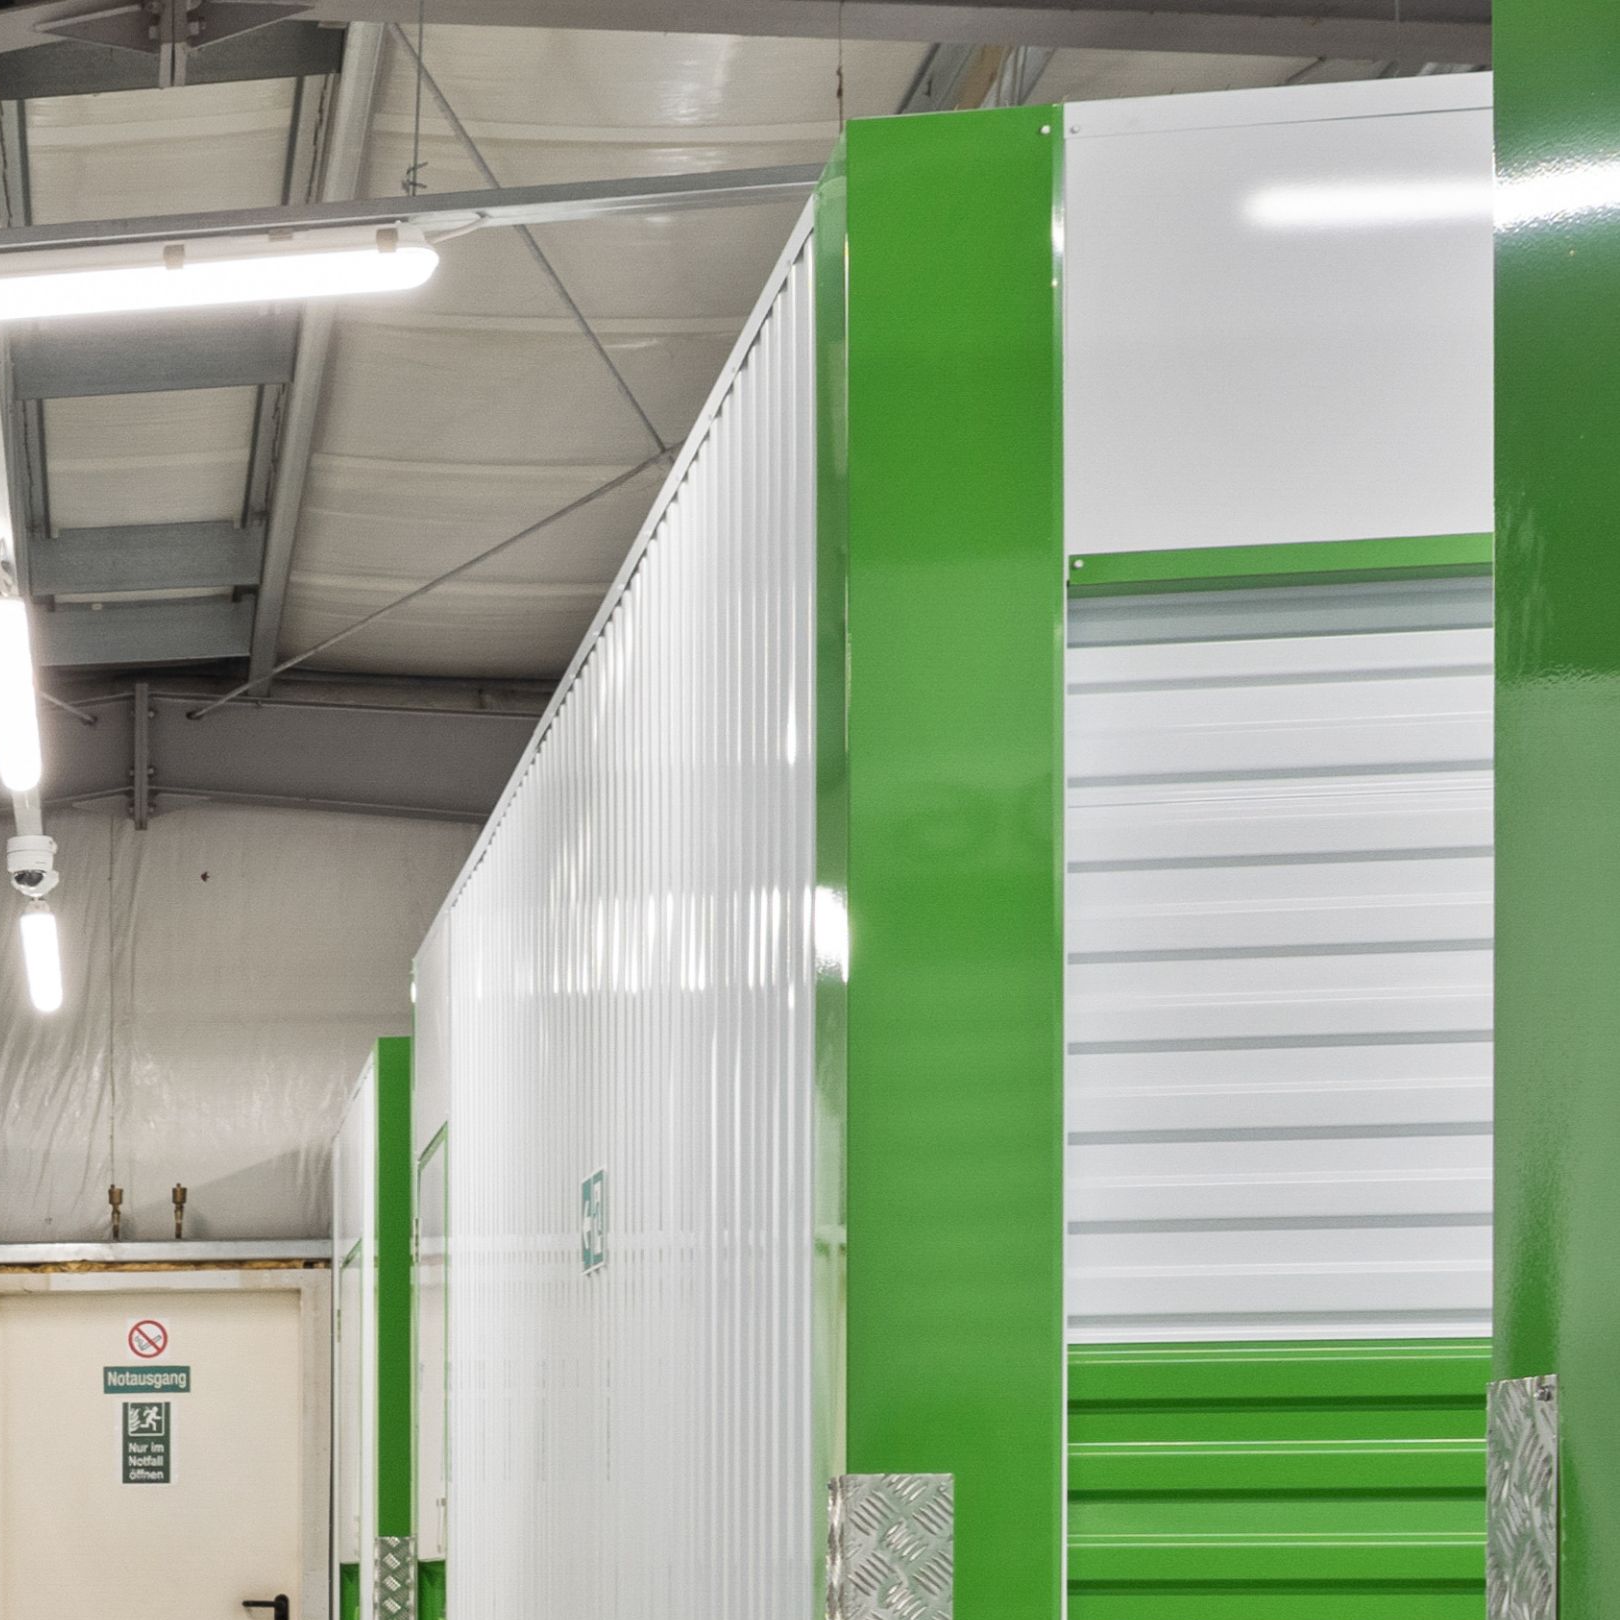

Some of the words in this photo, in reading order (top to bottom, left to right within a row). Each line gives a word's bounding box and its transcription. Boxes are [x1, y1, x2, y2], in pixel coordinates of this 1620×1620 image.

[107, 1371, 187, 1389] Notausgang
[128, 1442, 148, 1453] Nur
[150, 1441, 165, 1453] im
[128, 1455, 164, 1467] Notfall
[129, 1468, 164, 1481] öffnen
